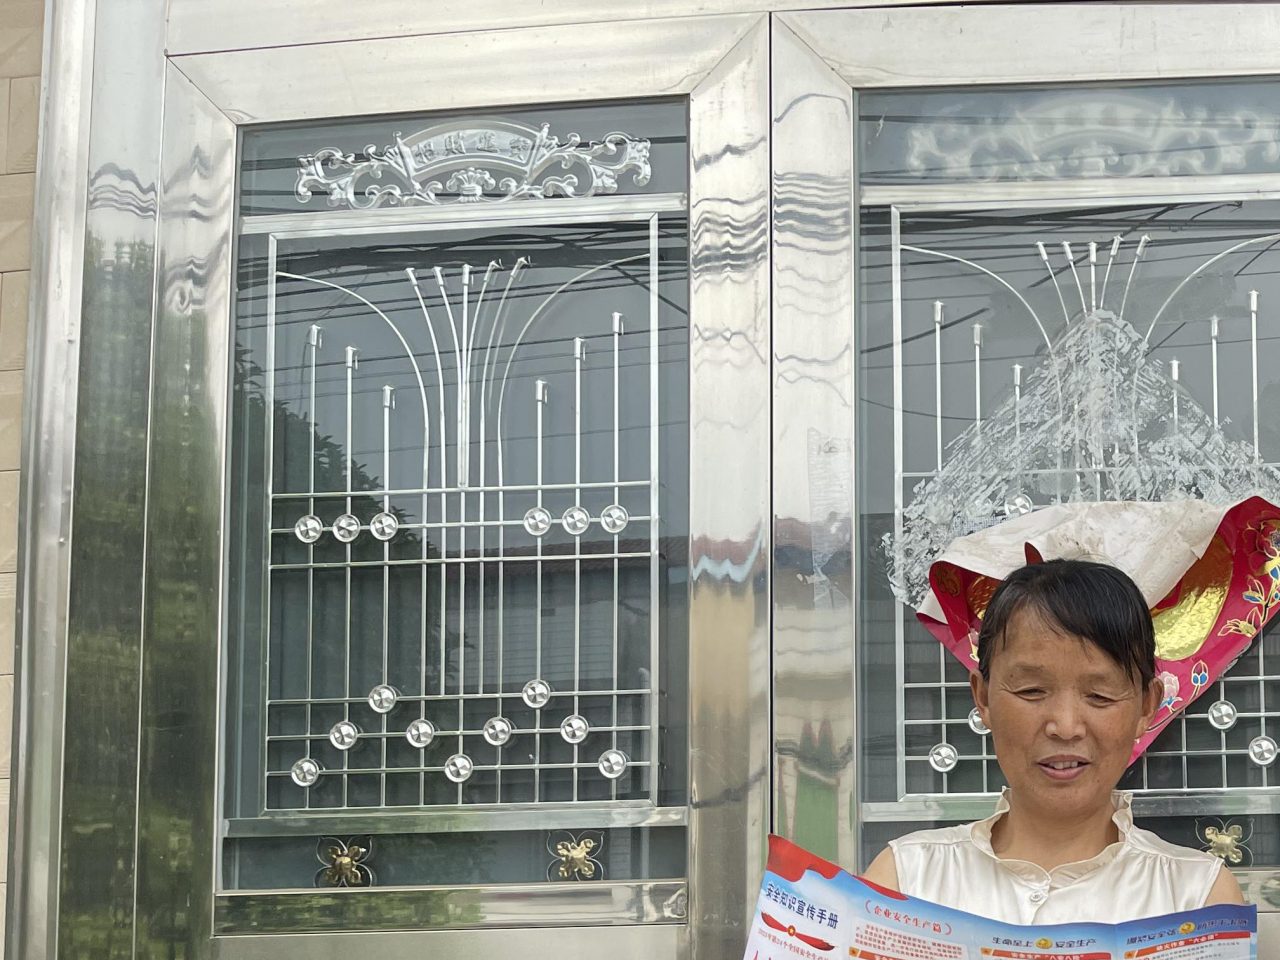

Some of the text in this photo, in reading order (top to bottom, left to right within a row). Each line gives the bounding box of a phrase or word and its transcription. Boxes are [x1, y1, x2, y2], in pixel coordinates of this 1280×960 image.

[766, 883, 838, 929] 安全知识宣传手册
[873, 905, 942, 933] 企业安全生产篇
[1055, 938, 1096, 949] 安全生产
